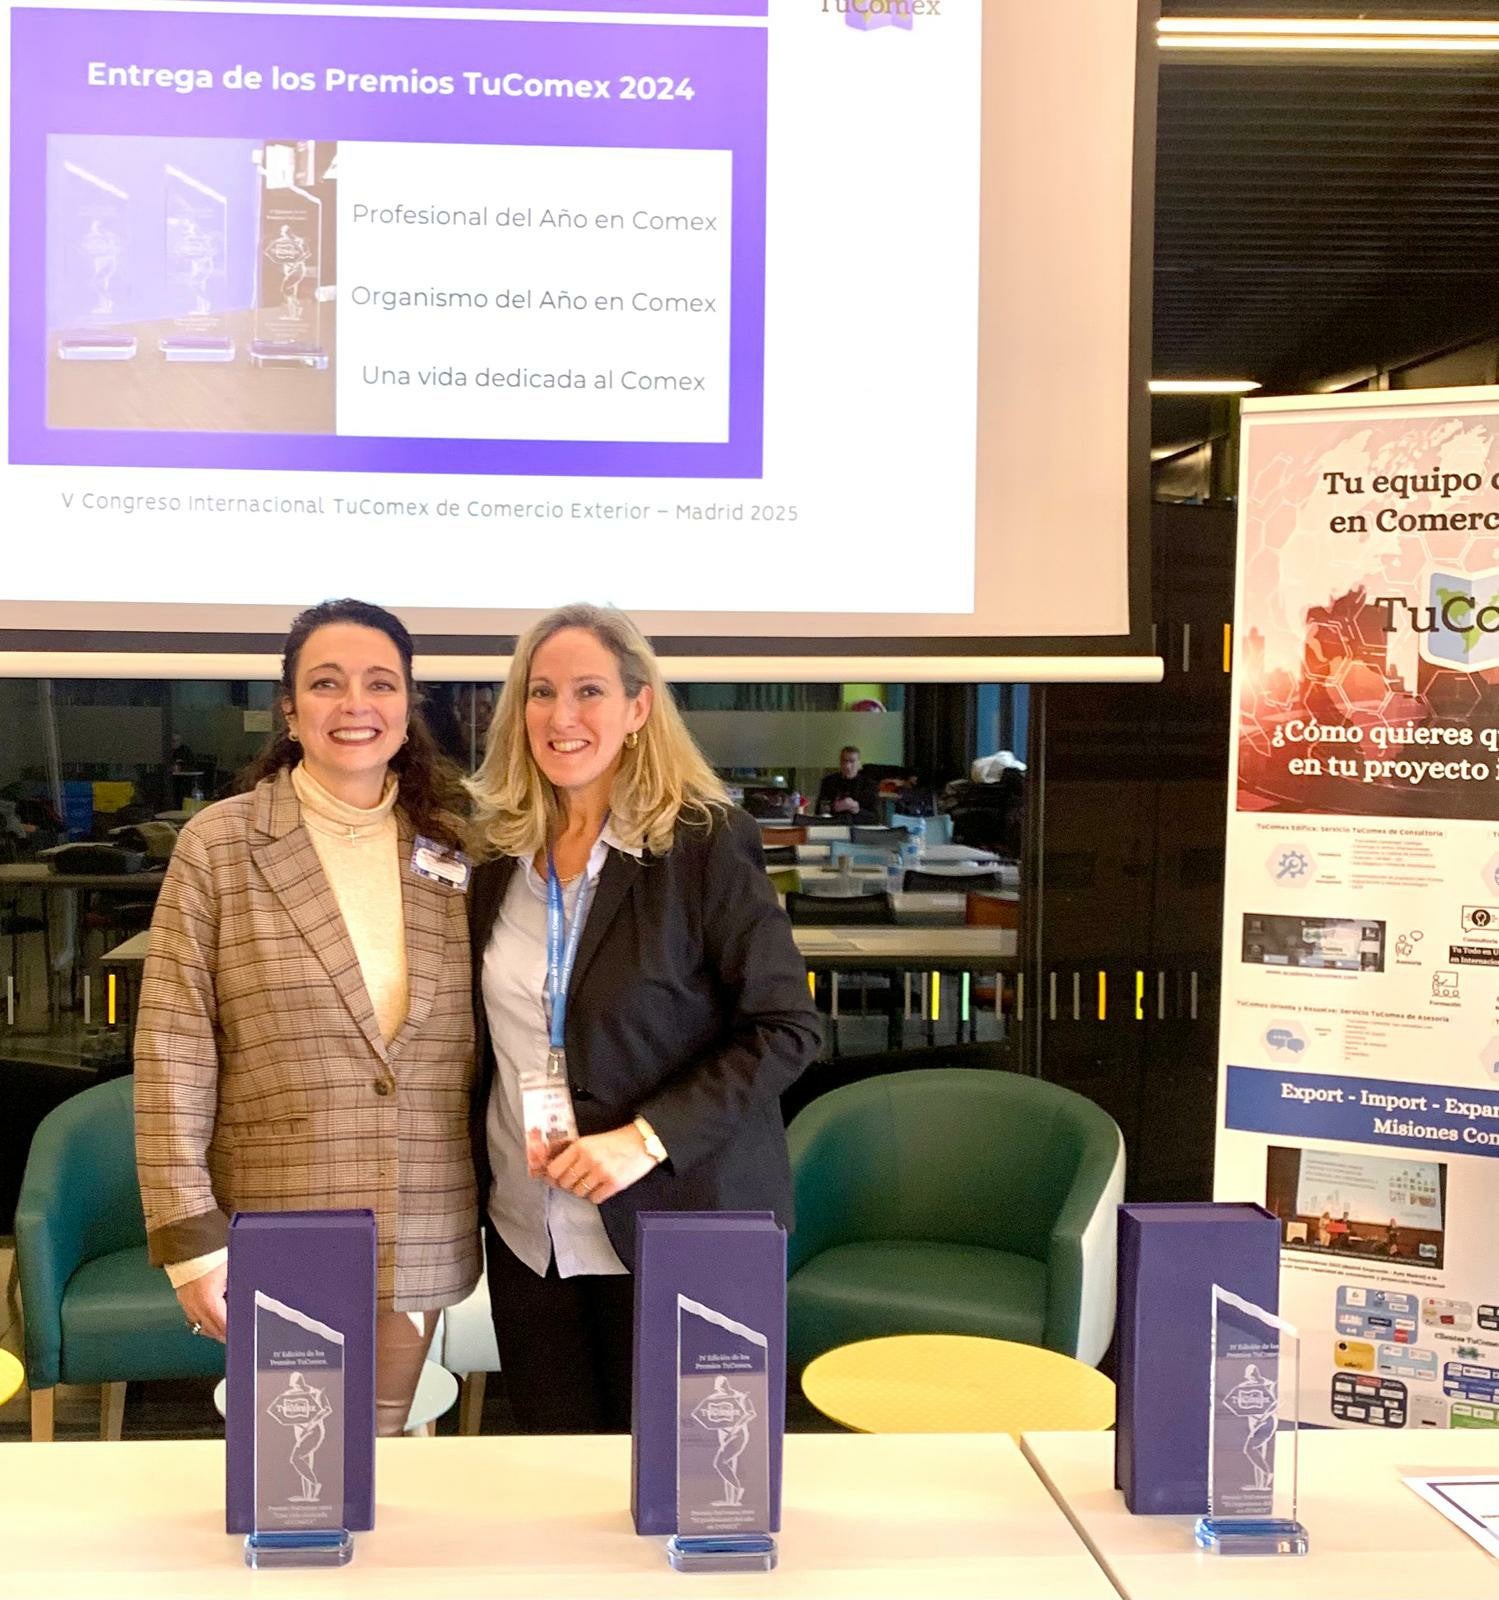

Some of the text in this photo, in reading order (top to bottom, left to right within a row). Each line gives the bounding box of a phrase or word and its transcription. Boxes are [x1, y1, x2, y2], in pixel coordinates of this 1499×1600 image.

[88, 62, 695, 100] Entrega de los Premios TuComex 2024
[354, 204, 716, 230] Profesional del Año en Comex
[352, 286, 716, 312] Organismo del Año en Comex
[363, 366, 704, 390] Una vida dedicada al Comex
[1323, 472, 1364, 494] Tu
[1373, 467, 1482, 499] equipo
[62, 493, 74, 508] V
[82, 493, 180, 514] Congreso
[189, 496, 325, 514] Internacional
[334, 499, 428, 515] TuComex
[437, 500, 459, 516] de
[467, 501, 563, 518] Comercio
[572, 503, 650, 519] Exterior
[677, 504, 743, 520] Madrid
[751, 505, 797, 521] 2025
[1330, 516, 1367, 533] en
[1272, 719, 1499, 752] ¿Cómo quieres q
[1288, 756, 1321, 776] en
[1328, 757, 1358, 777] tu
[1363, 756, 1489, 783] proyecto
[1281, 1083, 1343, 1103] Export
[1361, 1090, 1427, 1112] Import
[1374, 1118, 1459, 1142] Misiones
